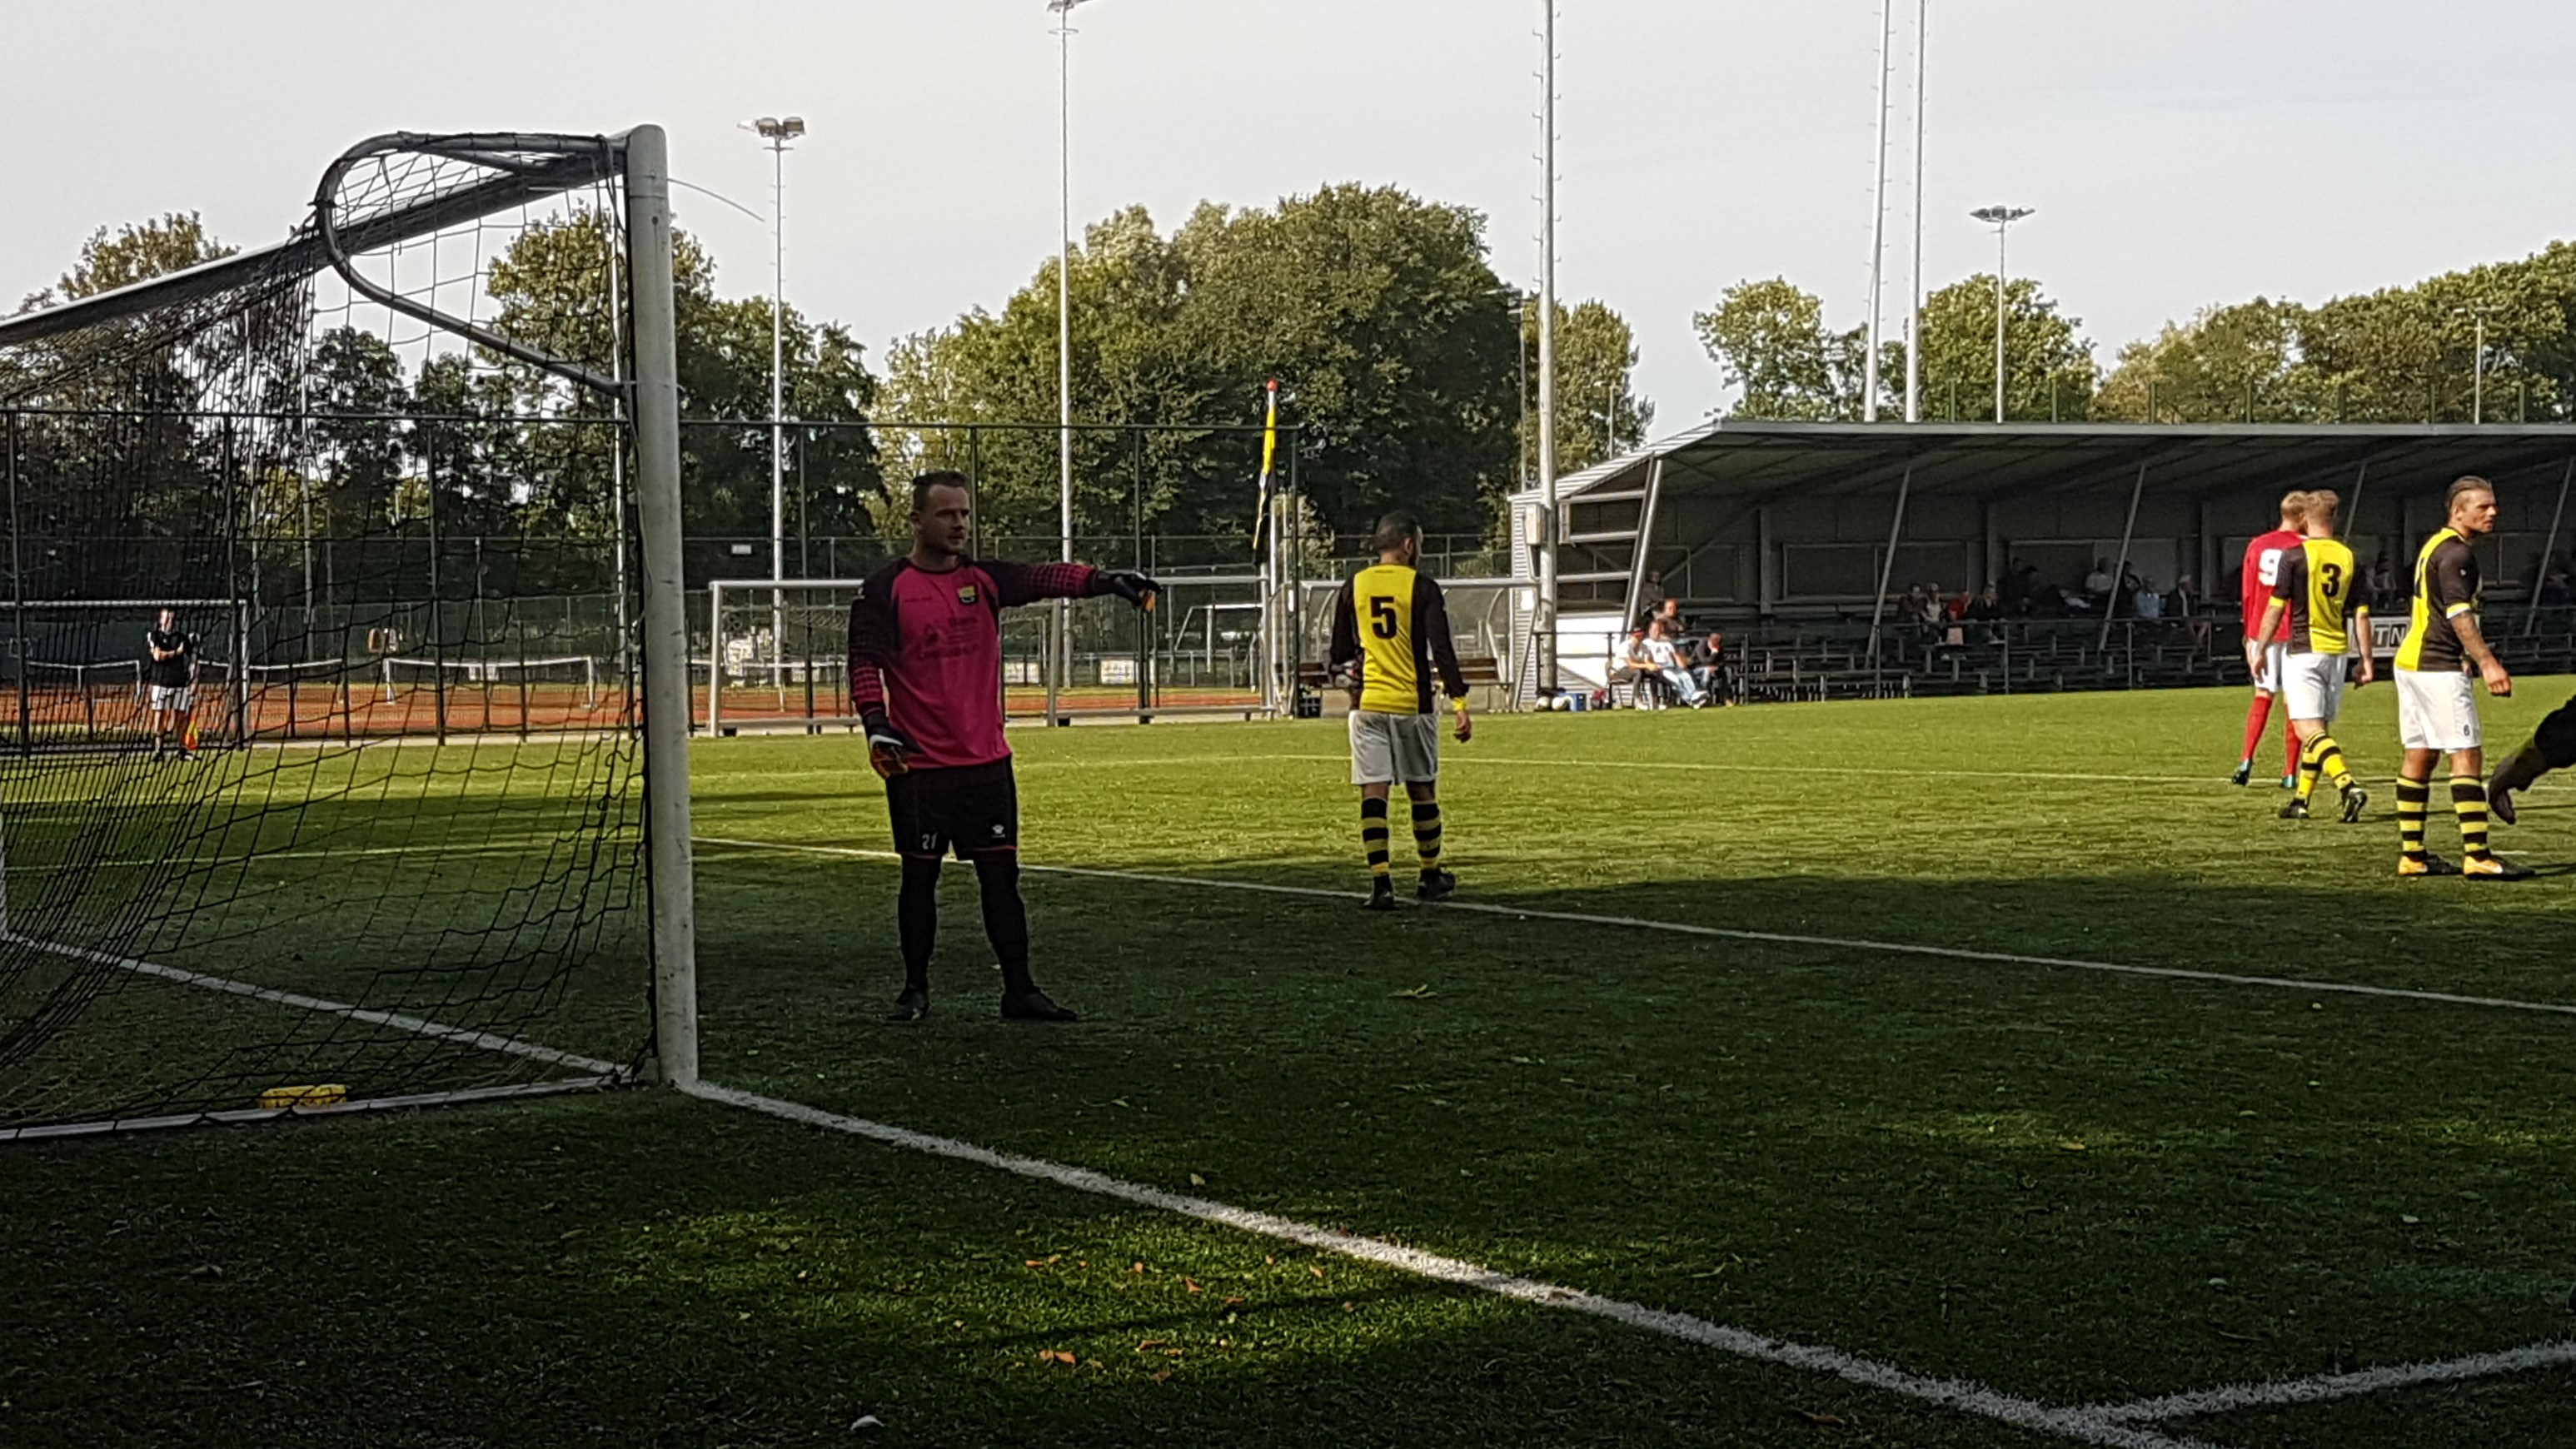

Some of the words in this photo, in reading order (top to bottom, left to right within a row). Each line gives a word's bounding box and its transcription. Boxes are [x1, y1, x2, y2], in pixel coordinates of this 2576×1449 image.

[2259, 549, 2282, 586] 9
[2321, 563, 2342, 597] 3
[1370, 595, 1398, 640] 5
[922, 833, 938, 849] 21
